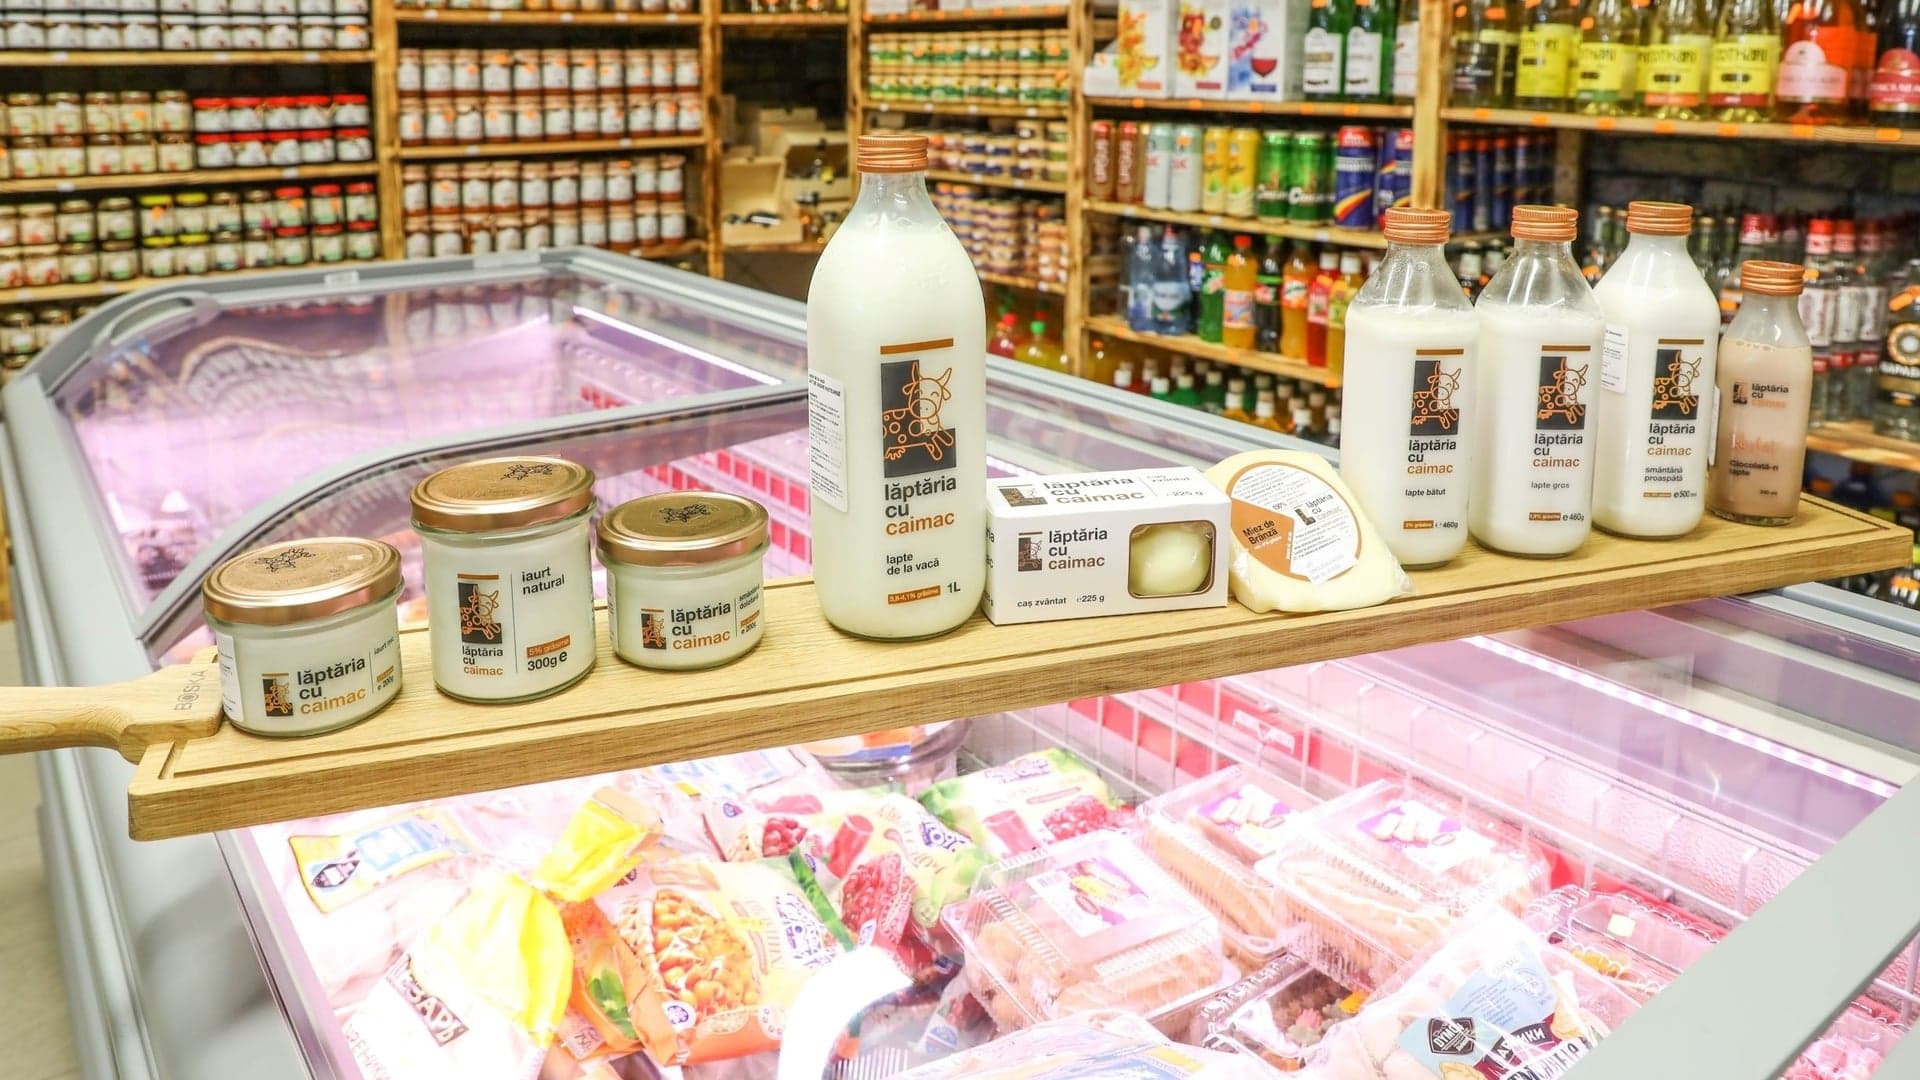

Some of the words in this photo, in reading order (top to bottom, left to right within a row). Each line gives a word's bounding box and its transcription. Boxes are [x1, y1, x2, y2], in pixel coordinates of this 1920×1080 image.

[1752, 384, 1789, 393] lăptăria
[1649, 423, 1695, 436] lăptăria
[1409, 439, 1456, 453] lăptăria
[1534, 433, 1583, 447] lăptăria
[1648, 435, 1664, 445] cu
[1534, 447, 1550, 456] cu
[1648, 445, 1692, 456] caimac
[1407, 453, 1424, 463] cu
[1533, 456, 1580, 467] caimac
[1407, 463, 1453, 474] caimac
[1645, 466, 1683, 474] smântână
[1043, 476, 1135, 491] lăptăria
[1644, 474, 1683, 483] proaspătă
[884, 475, 957, 502] lăptăria
[1050, 488, 1080, 496] cu
[1531, 481, 1550, 489] lapte
[1552, 482, 1570, 490] gros
[1056, 491, 1145, 504] caimac
[1405, 488, 1425, 497] lapte
[1426, 488, 1446, 496] bătut
[885, 503, 909, 518] cu
[1311, 506, 1322, 515] cu
[886, 512, 955, 536] caimac
[1242, 525, 1264, 538] Miez
[1263, 520, 1275, 529] de
[1049, 528, 1108, 547] lăptăria
[1248, 527, 1279, 545] Brânză
[1049, 546, 1068, 557] cu
[886, 553, 913, 566] lapte
[1048, 556, 1105, 570] caimac
[887, 565, 901, 575] de
[903, 564, 913, 573] la
[915, 558, 940, 571] vacă
[521, 566, 552, 582] iaurt
[522, 574, 565, 595] natural
[947, 581, 961, 593] 1L
[1035, 597, 1067, 606] zvântat
[1099, 595, 1105, 603] g
[671, 602, 731, 624] lăptăria
[672, 624, 692, 636] cu
[672, 630, 731, 650] caimac
[462, 646, 504, 658] lăptăria
[463, 656, 475, 665] cu
[527, 656, 557, 671] 300g
[297, 657, 366, 686] lăptăria
[463, 665, 503, 676] caimac
[299, 686, 322, 700] cu
[300, 687, 367, 715] caimac
